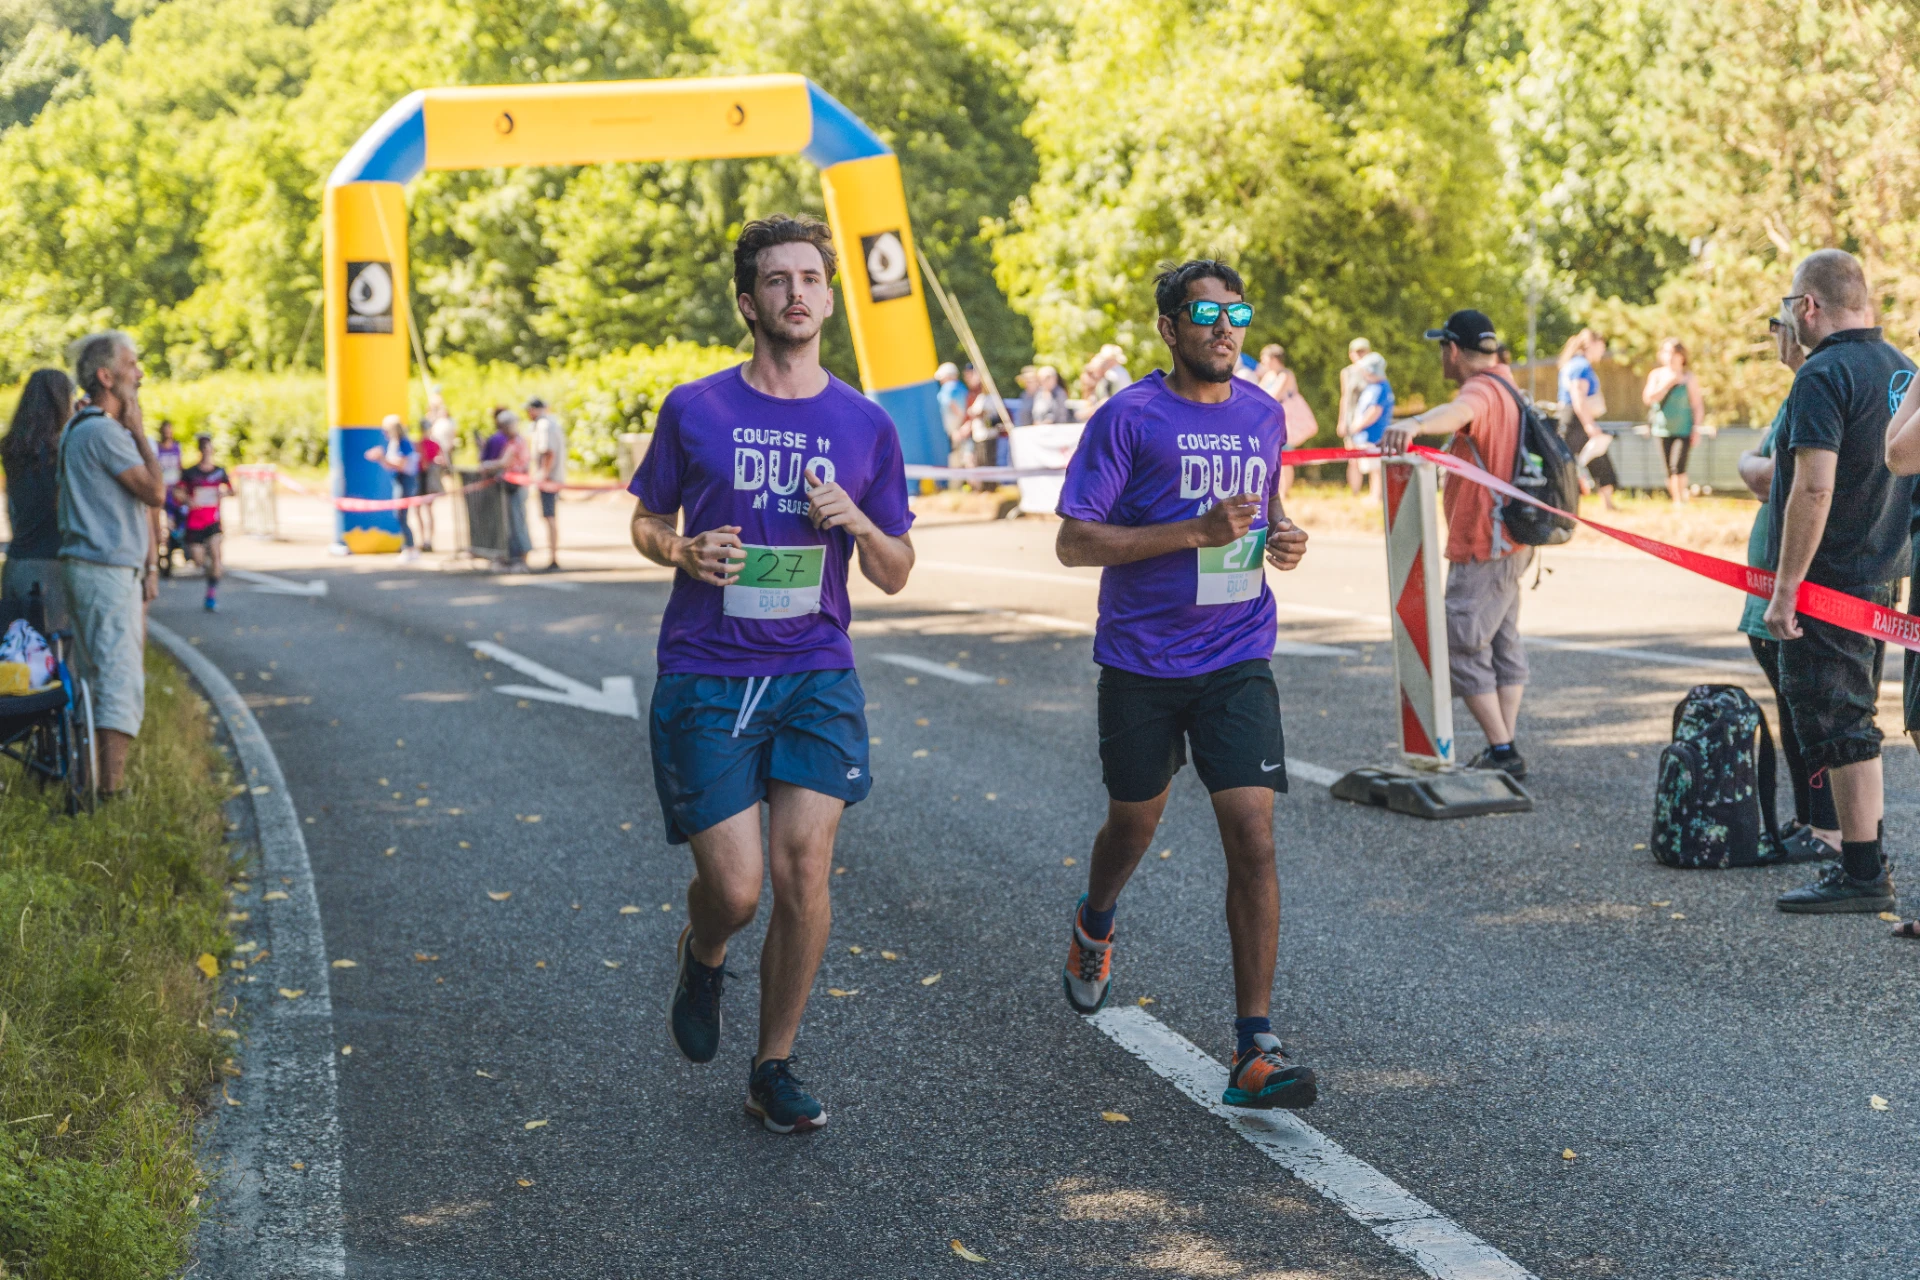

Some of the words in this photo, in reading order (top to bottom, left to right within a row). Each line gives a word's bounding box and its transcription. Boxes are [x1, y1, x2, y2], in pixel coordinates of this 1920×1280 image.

[732, 427, 807, 449] COURSE
[1177, 433, 1242, 451] COURSE
[733, 448, 836, 496] DUO
[1180, 455, 1267, 499] DUO
[777, 498, 809, 516] SUIS
[1223, 536, 1258, 569] 27
[756, 553, 804, 582] 27
[1227, 579, 1248, 593] DUO
[1746, 570, 1776, 594] RAIFF
[759, 595, 790, 608] DUO
[1873, 610, 1920, 643] RAIFFEIS
